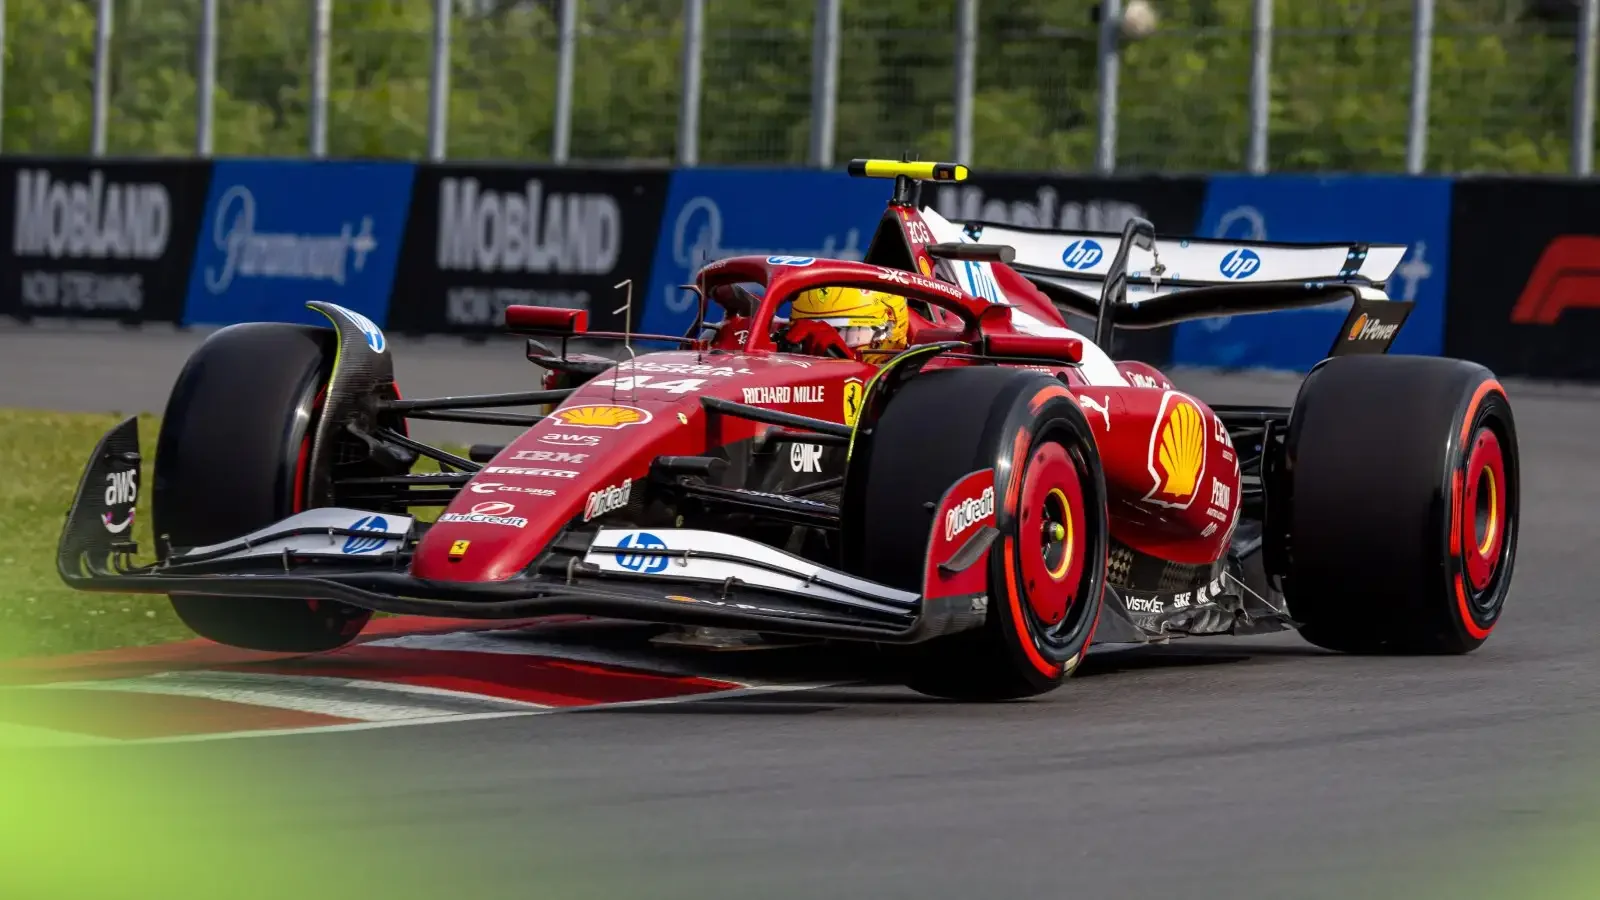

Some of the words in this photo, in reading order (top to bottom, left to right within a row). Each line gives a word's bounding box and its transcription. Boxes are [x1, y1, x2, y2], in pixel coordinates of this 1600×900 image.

[1065, 240, 1103, 269] hp
[1221, 248, 1259, 279] hp
[877, 267, 911, 285] DXC
[911, 276, 962, 299] TECHNOLOGY
[592, 375, 708, 394] 44
[742, 386, 791, 404] RICHARD
[793, 386, 825, 403] MILLE
[542, 433, 603, 445] aws
[509, 450, 590, 464] IBM
[105, 469, 137, 506] aws
[438, 512, 529, 529] UniCredit
[951, 486, 995, 536] UniCredit
[1173, 591, 1192, 608] SKF
